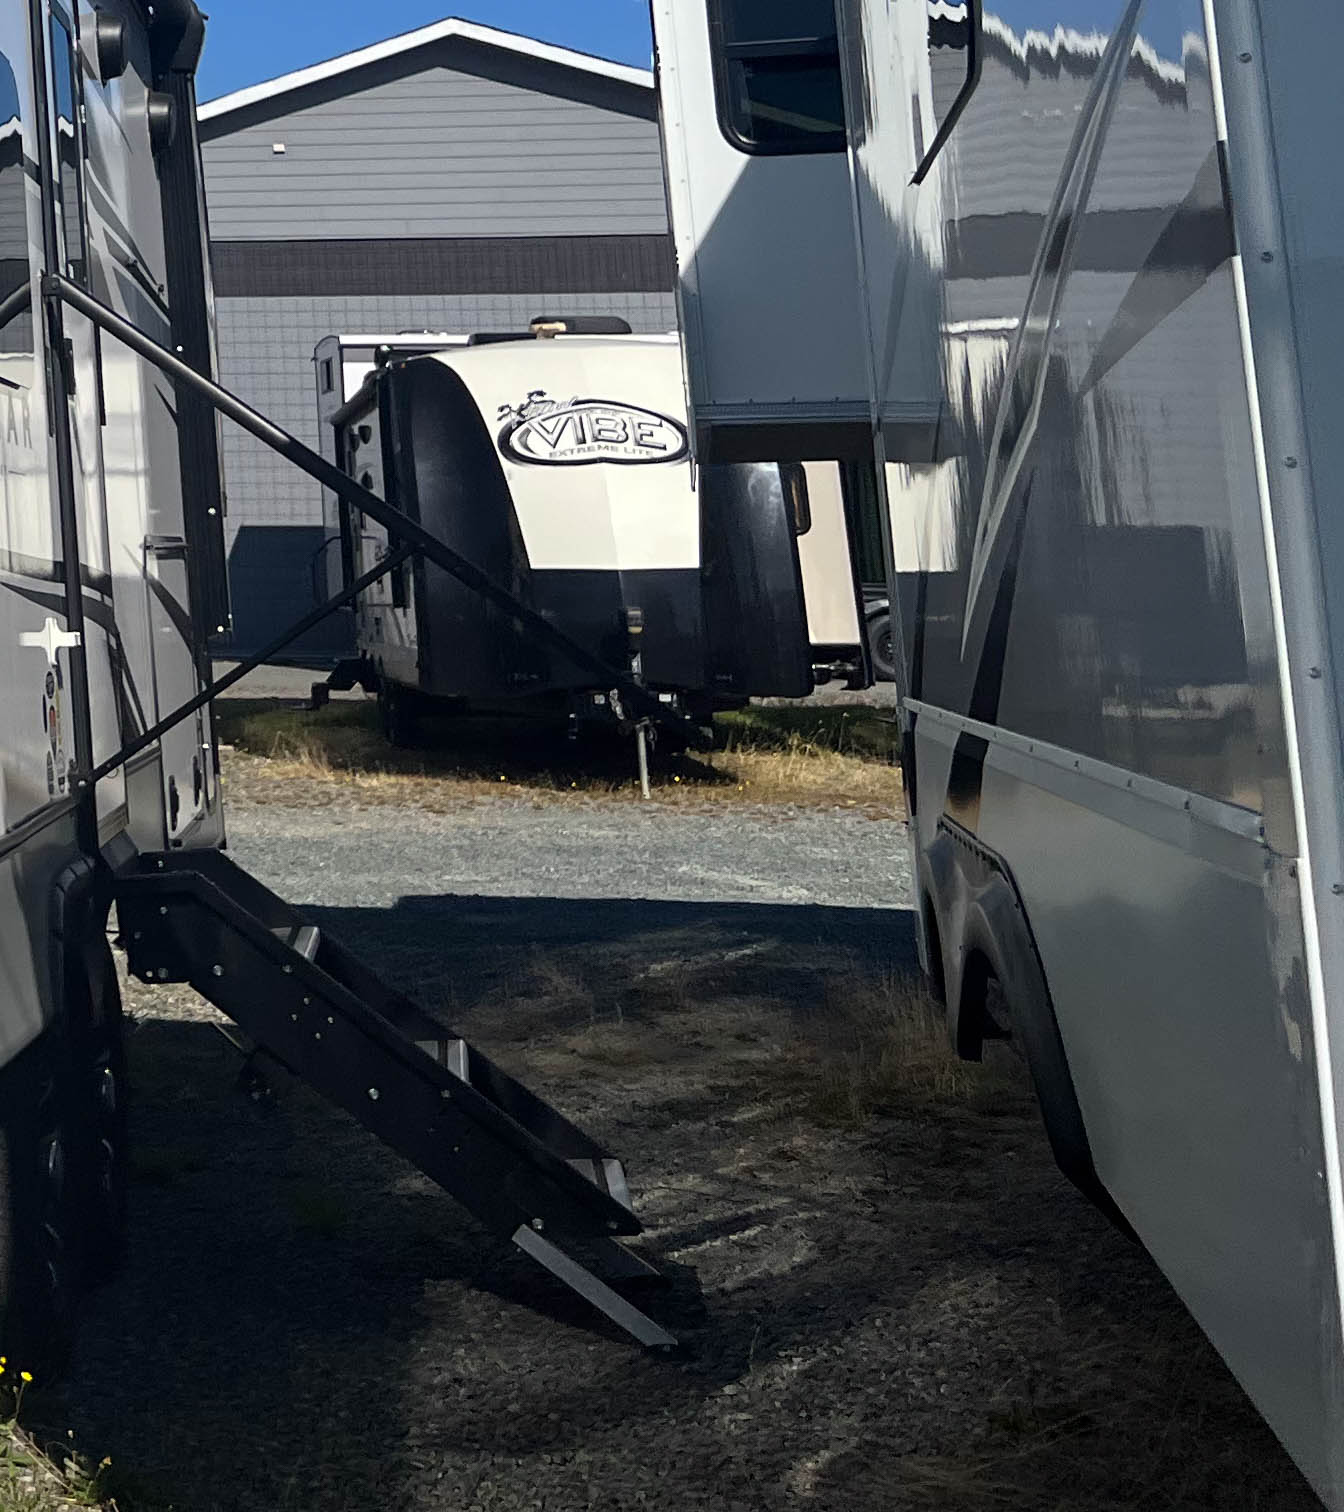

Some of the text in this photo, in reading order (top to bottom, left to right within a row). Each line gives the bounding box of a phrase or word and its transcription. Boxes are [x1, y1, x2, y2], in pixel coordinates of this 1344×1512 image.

[527, 413, 668, 451] VIBE
[548, 445, 654, 458] EXTREME LITE
